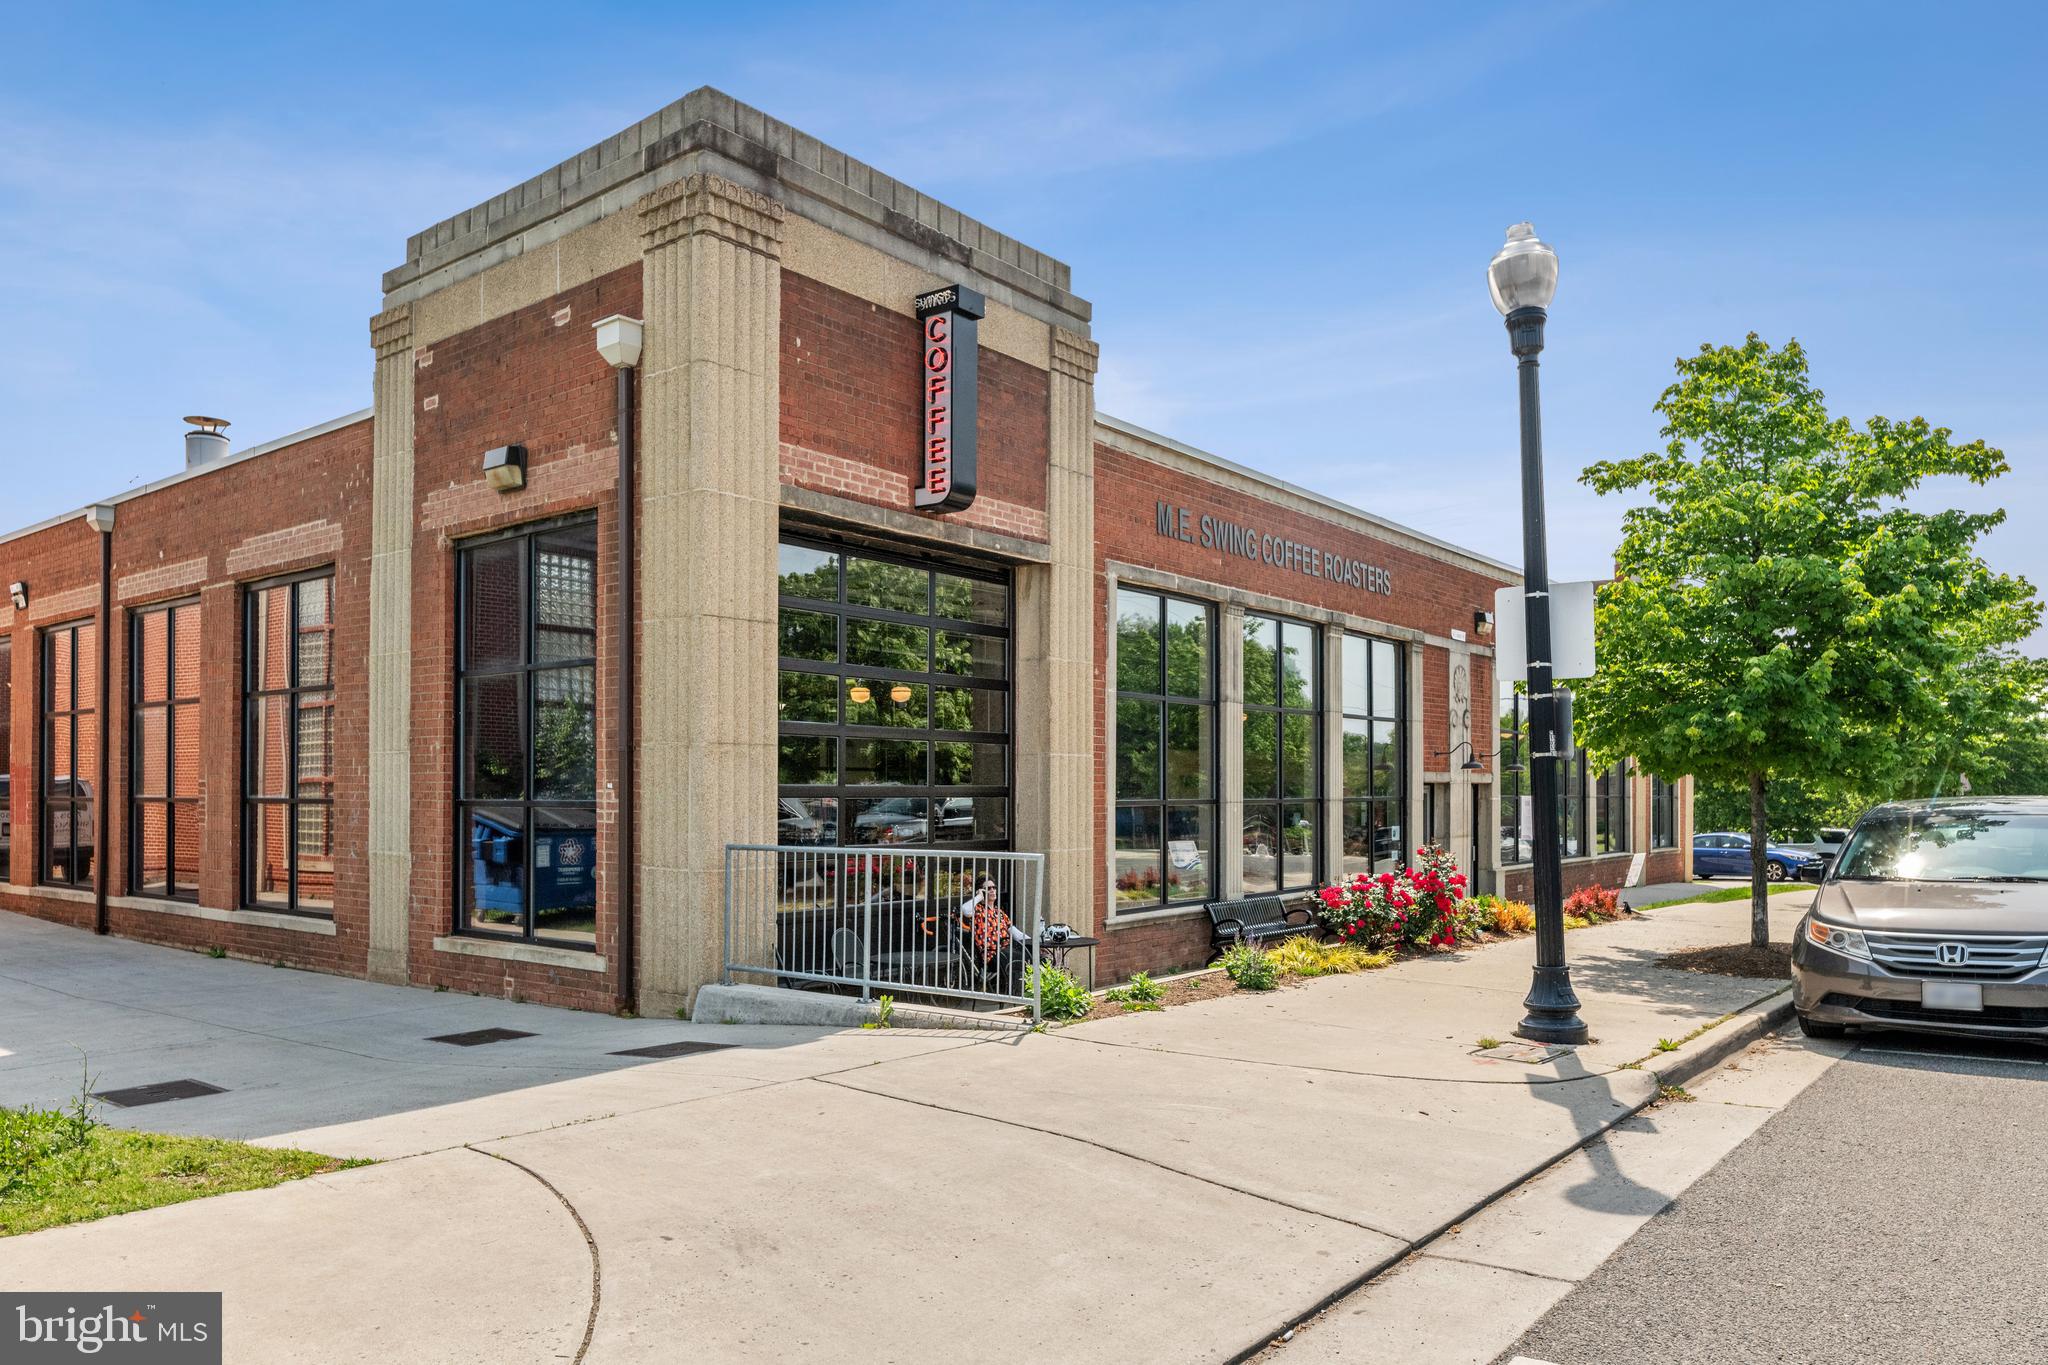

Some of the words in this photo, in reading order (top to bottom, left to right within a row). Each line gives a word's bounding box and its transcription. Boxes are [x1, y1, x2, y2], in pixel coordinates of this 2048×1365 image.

[925, 316, 948, 495] COFFEE
[1156, 500, 1196, 544] M.E.
[1200, 513, 1257, 560] SWING
[1261, 533, 1321, 578] COFFEE
[1323, 551, 1392, 596] ROASTERS
